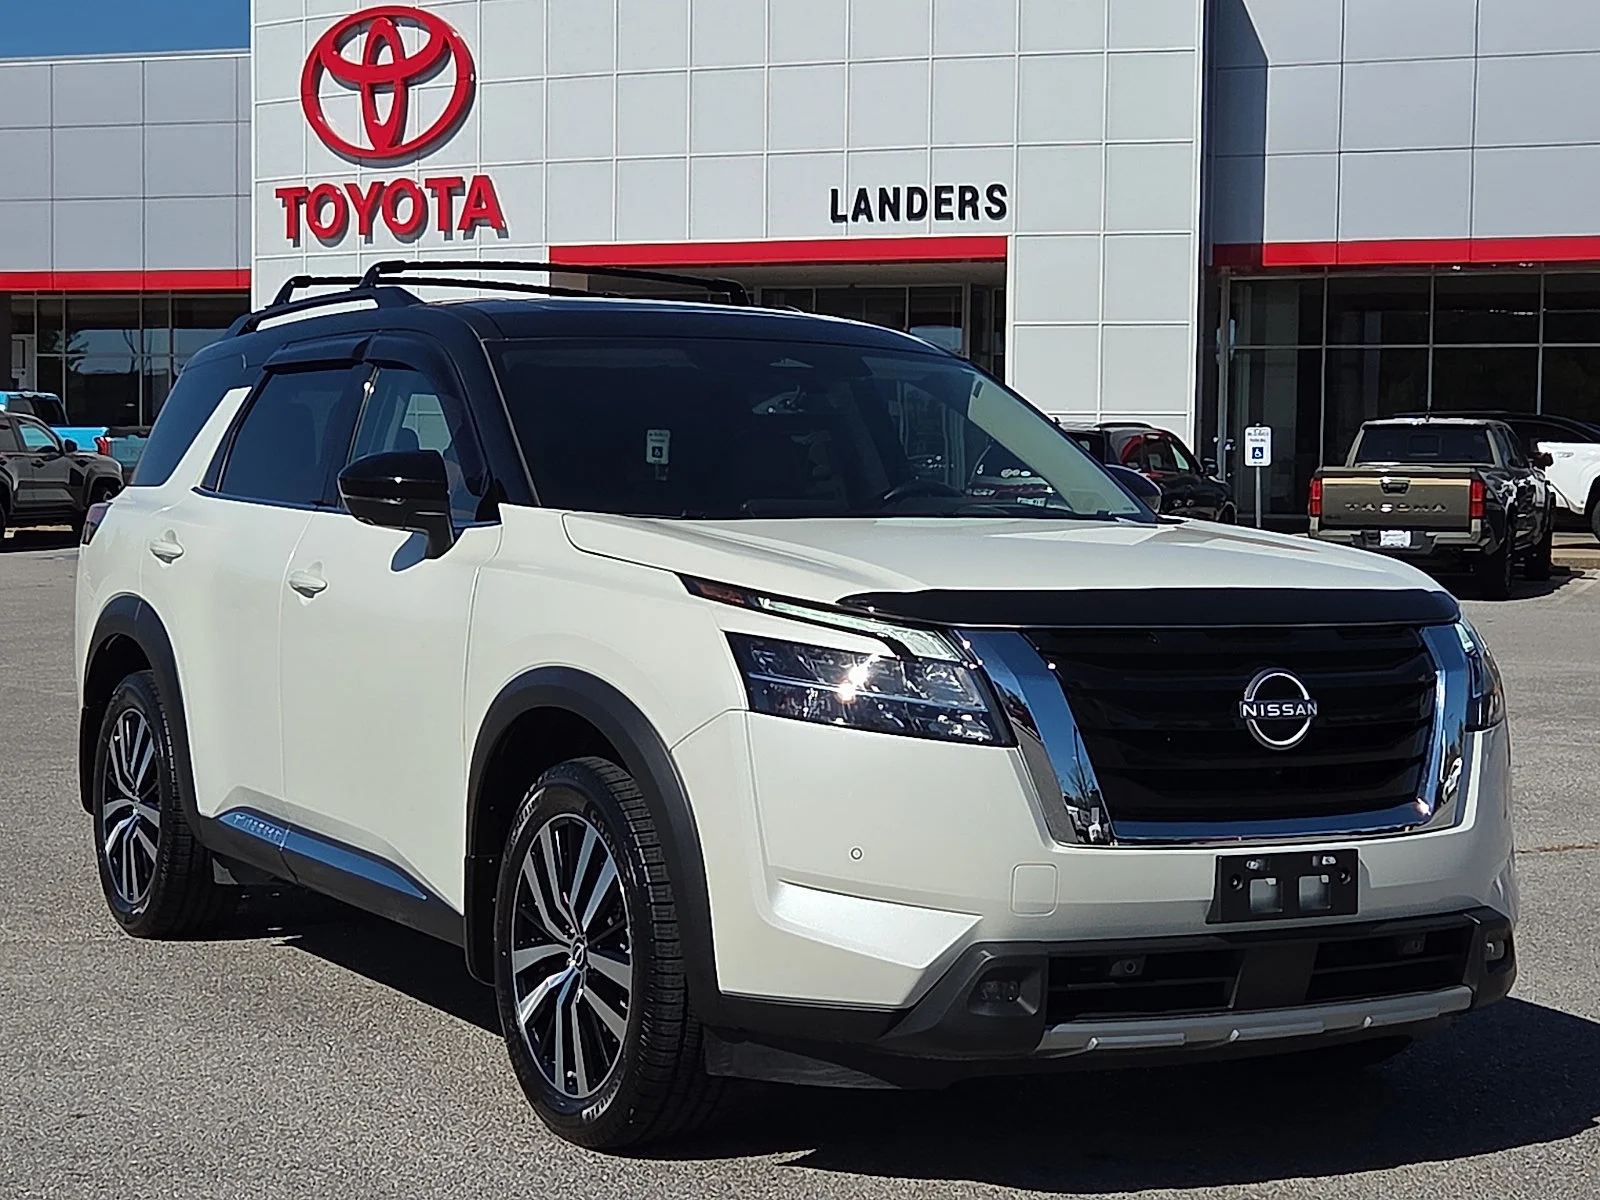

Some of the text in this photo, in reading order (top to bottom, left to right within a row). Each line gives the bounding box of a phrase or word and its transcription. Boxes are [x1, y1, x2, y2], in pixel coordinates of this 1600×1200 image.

[275, 174, 507, 245] TOYOTA
[830, 183, 1008, 224] LANDERS
[1241, 702, 1318, 717] NISSAN
